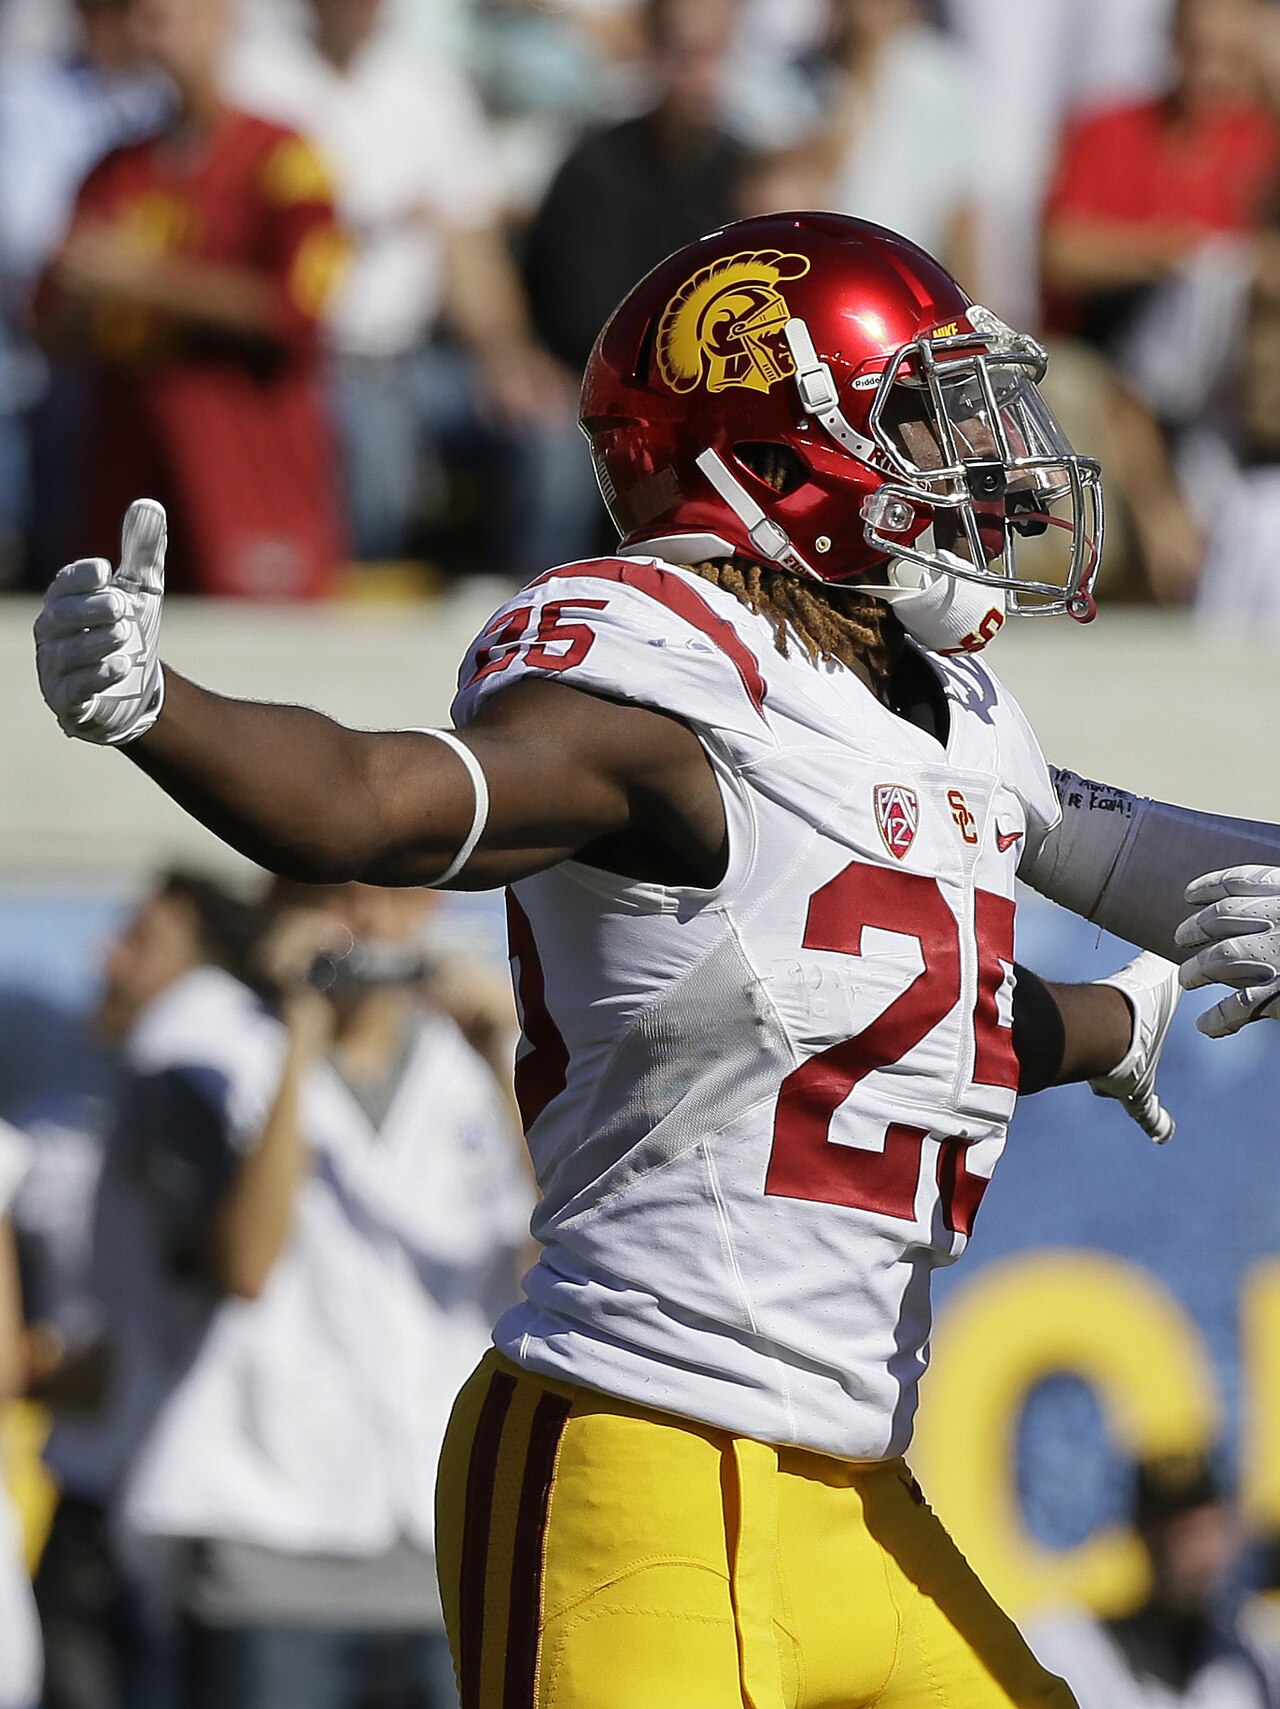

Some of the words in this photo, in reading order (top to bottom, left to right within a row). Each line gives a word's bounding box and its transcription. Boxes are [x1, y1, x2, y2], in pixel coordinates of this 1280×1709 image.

[932, 323, 959, 339] NIKE
[463, 599, 611, 690] 25
[886, 817, 911, 846] 12
[947, 789, 979, 844] SC
